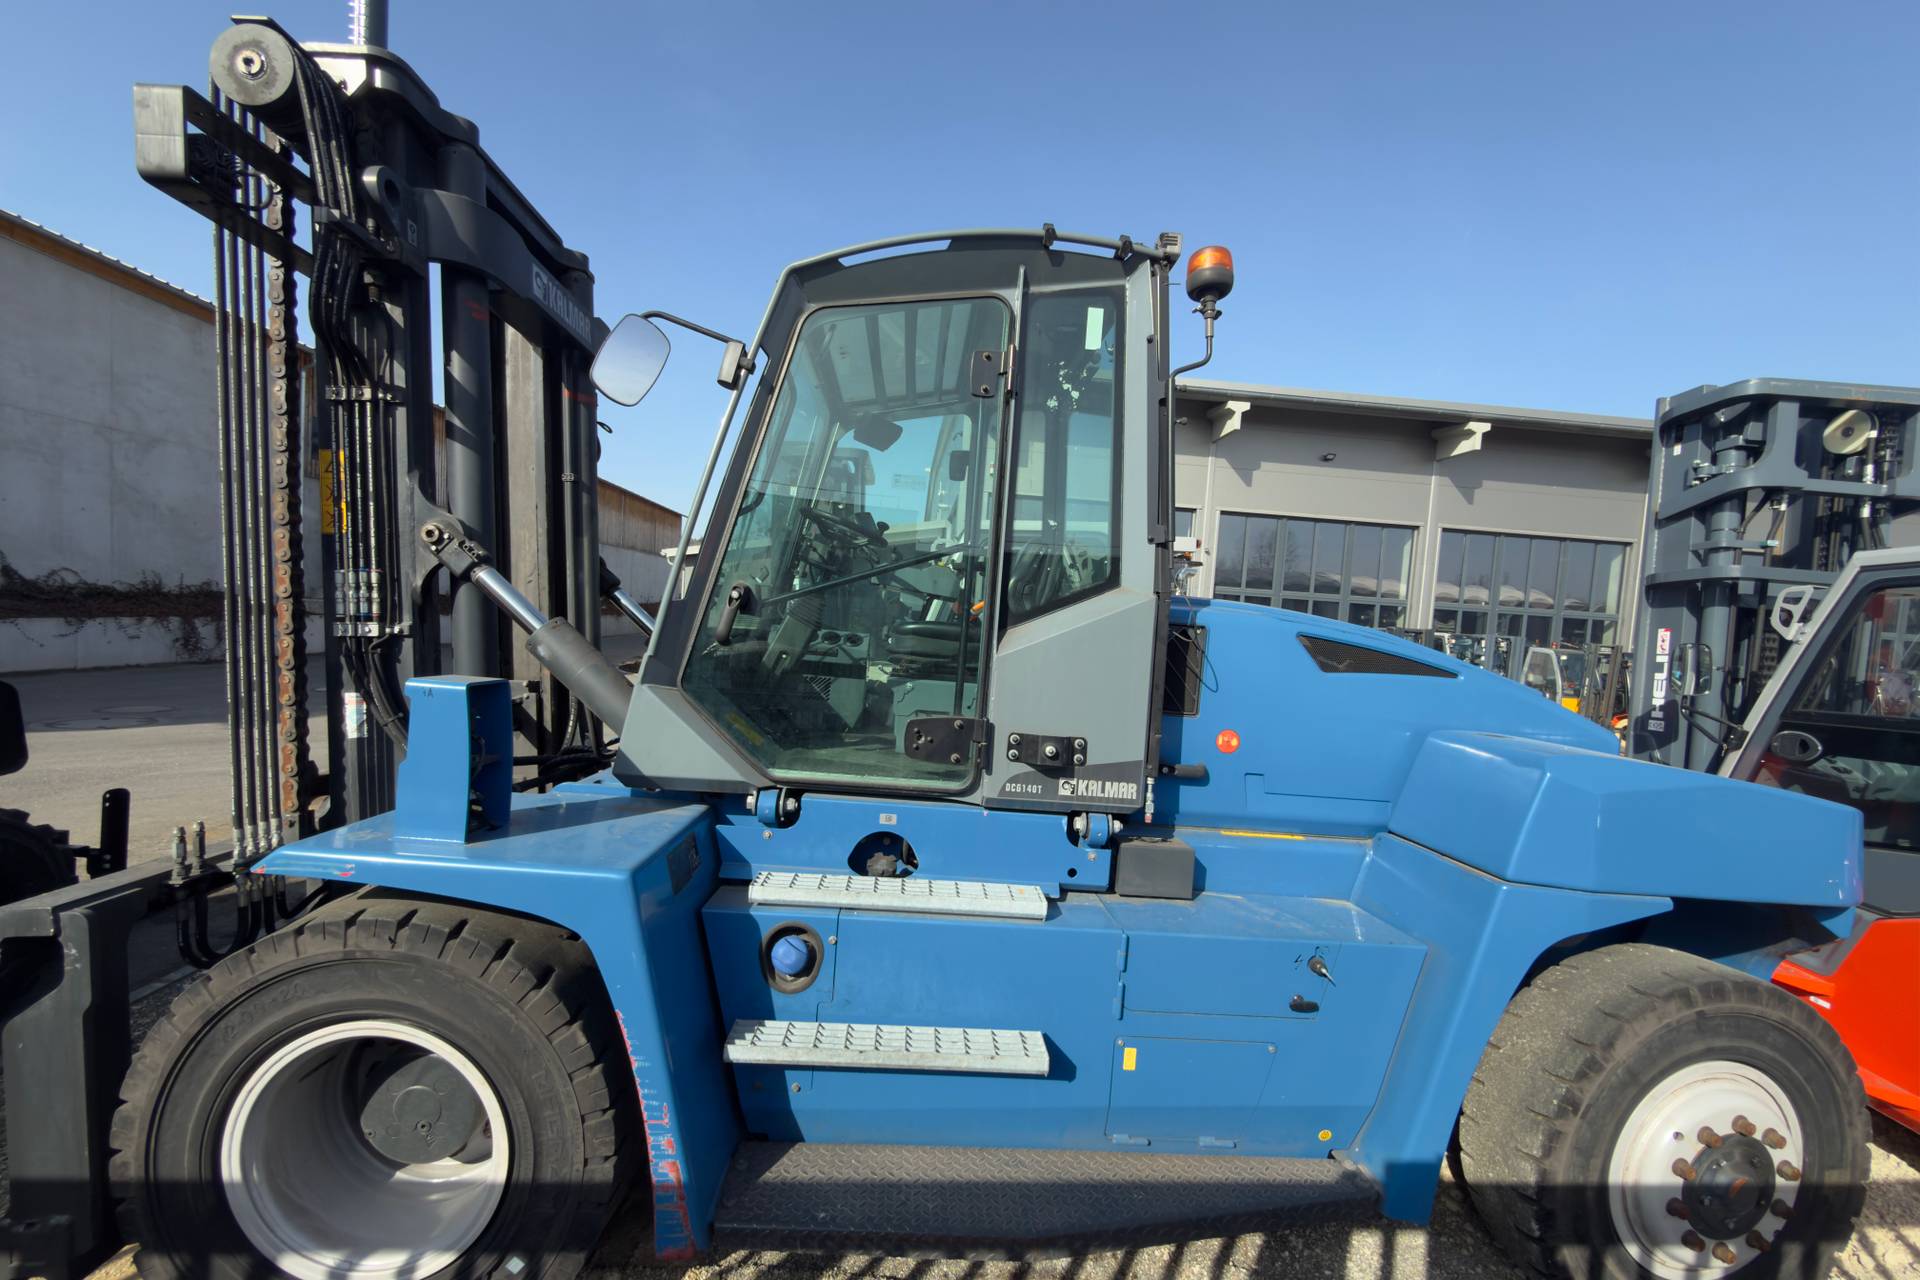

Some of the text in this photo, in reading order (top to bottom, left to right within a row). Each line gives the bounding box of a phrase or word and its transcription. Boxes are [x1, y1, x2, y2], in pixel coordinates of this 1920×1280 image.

[548, 281, 592, 344] KALMAR
[1651, 655, 1668, 718] HELI
[1005, 782, 1042, 794] DCG140T
[1078, 779, 1137, 800] KALMAR
